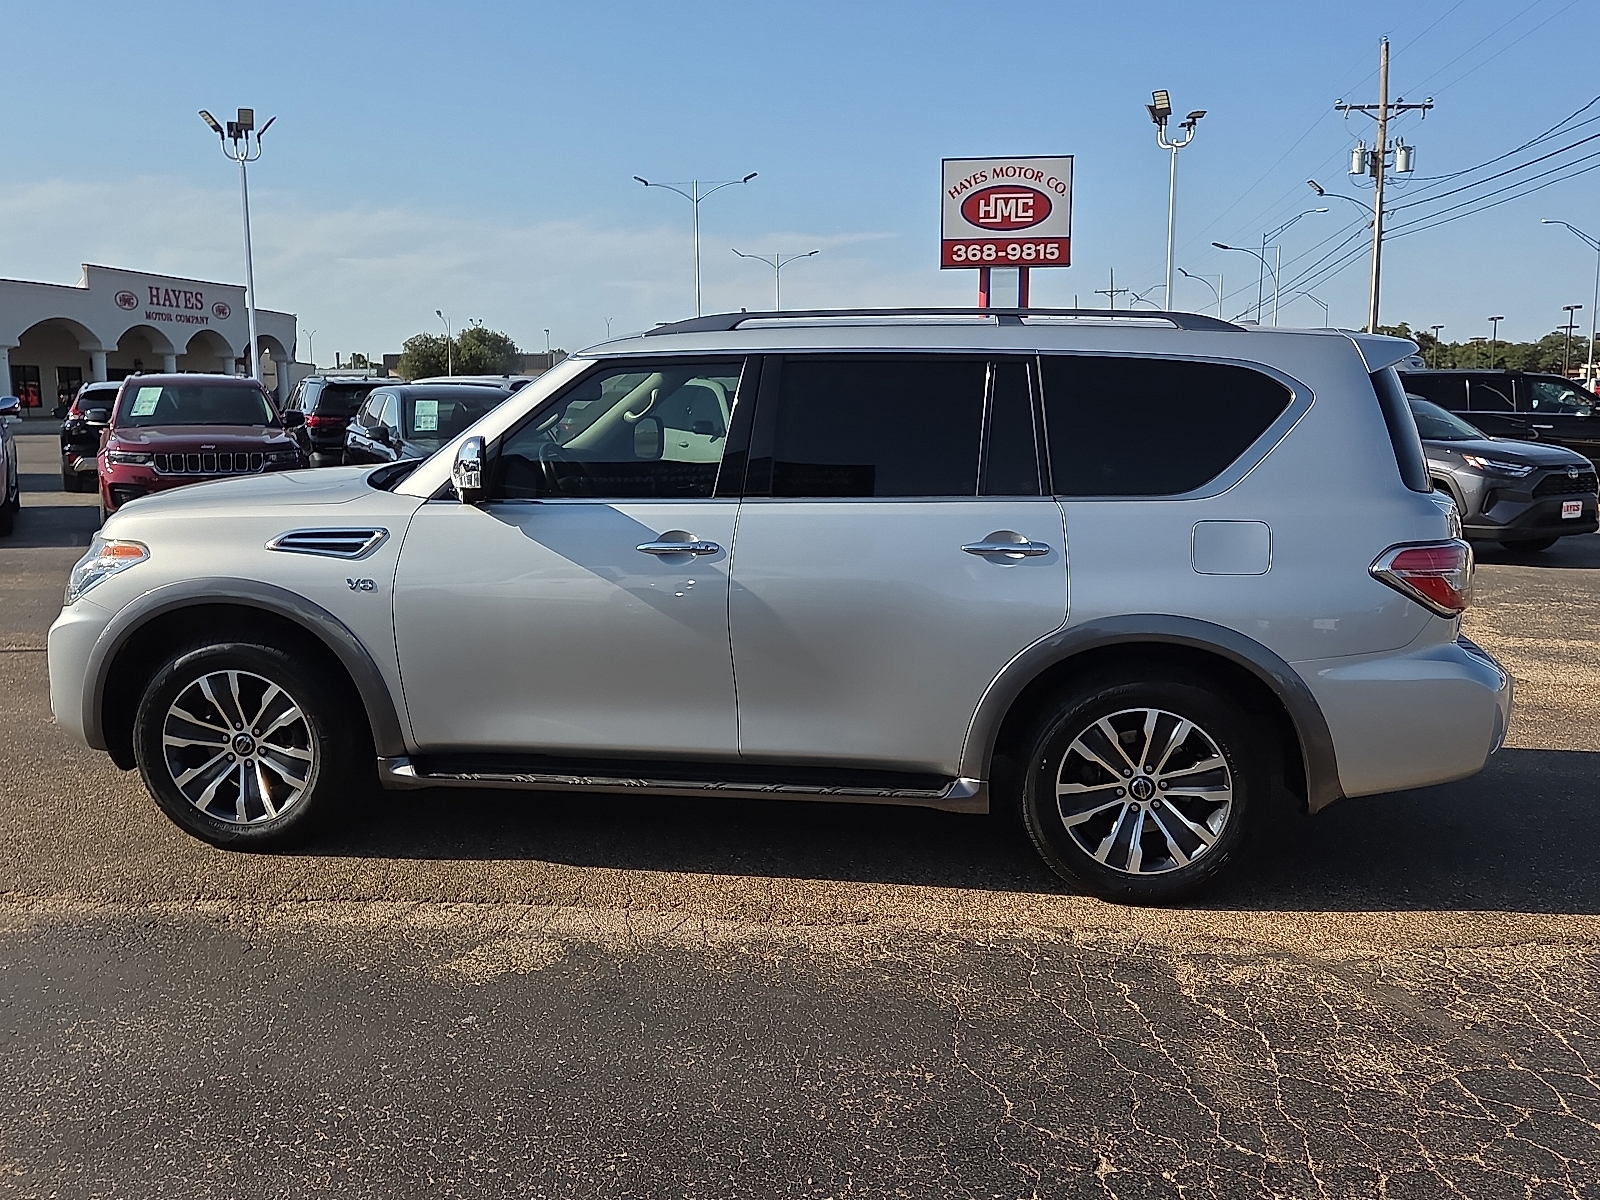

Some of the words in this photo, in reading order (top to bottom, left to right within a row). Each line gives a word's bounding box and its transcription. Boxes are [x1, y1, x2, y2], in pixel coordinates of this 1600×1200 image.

[948, 170, 988, 199] HAYES
[992, 166, 1044, 183] MOTOR
[1046, 176, 1067, 197] CO.
[979, 193, 1034, 222] HMC
[952, 243, 1060, 261] 368-9815
[148, 286, 204, 310] HAYES
[145, 311, 173, 322] MOTOR
[175, 314, 210, 325] COMPANY
[346, 578, 374, 591] V8
